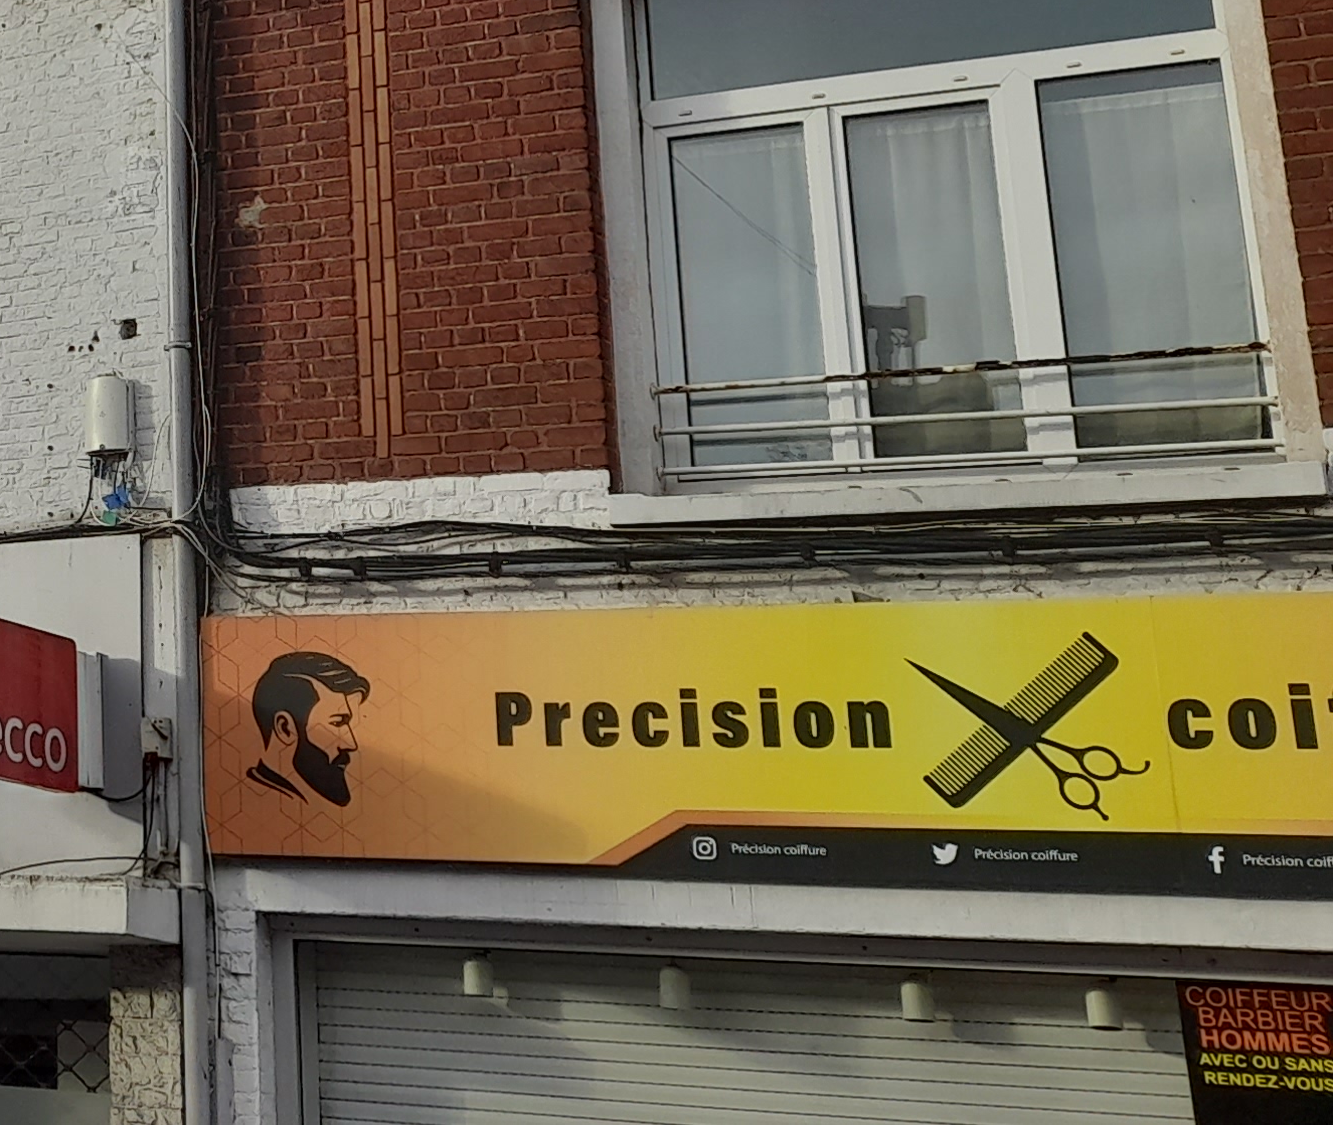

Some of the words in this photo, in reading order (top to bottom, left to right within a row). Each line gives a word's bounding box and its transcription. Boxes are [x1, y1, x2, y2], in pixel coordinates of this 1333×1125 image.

[494, 688, 893, 749] Precision
[1167, 683, 1333, 750] coi
[731, 842, 782, 855] Précision
[783, 843, 827, 856] coiffure
[974, 848, 1029, 860] Précision
[1031, 849, 1079, 862] coiffure
[1242, 854, 1304, 867] Précision
[1185, 985, 1333, 1012] COIFFEUR
[1198, 1006, 1326, 1033] BARBIER
[1200, 1028, 1331, 1055] HOMMES
[1199, 1052, 1248, 1068] AVEC
[1252, 1055, 1280, 1070] OU
[1284, 1057, 1333, 1074] SANS
[1203, 1071, 1333, 1092] RENDEZ-VOUS
